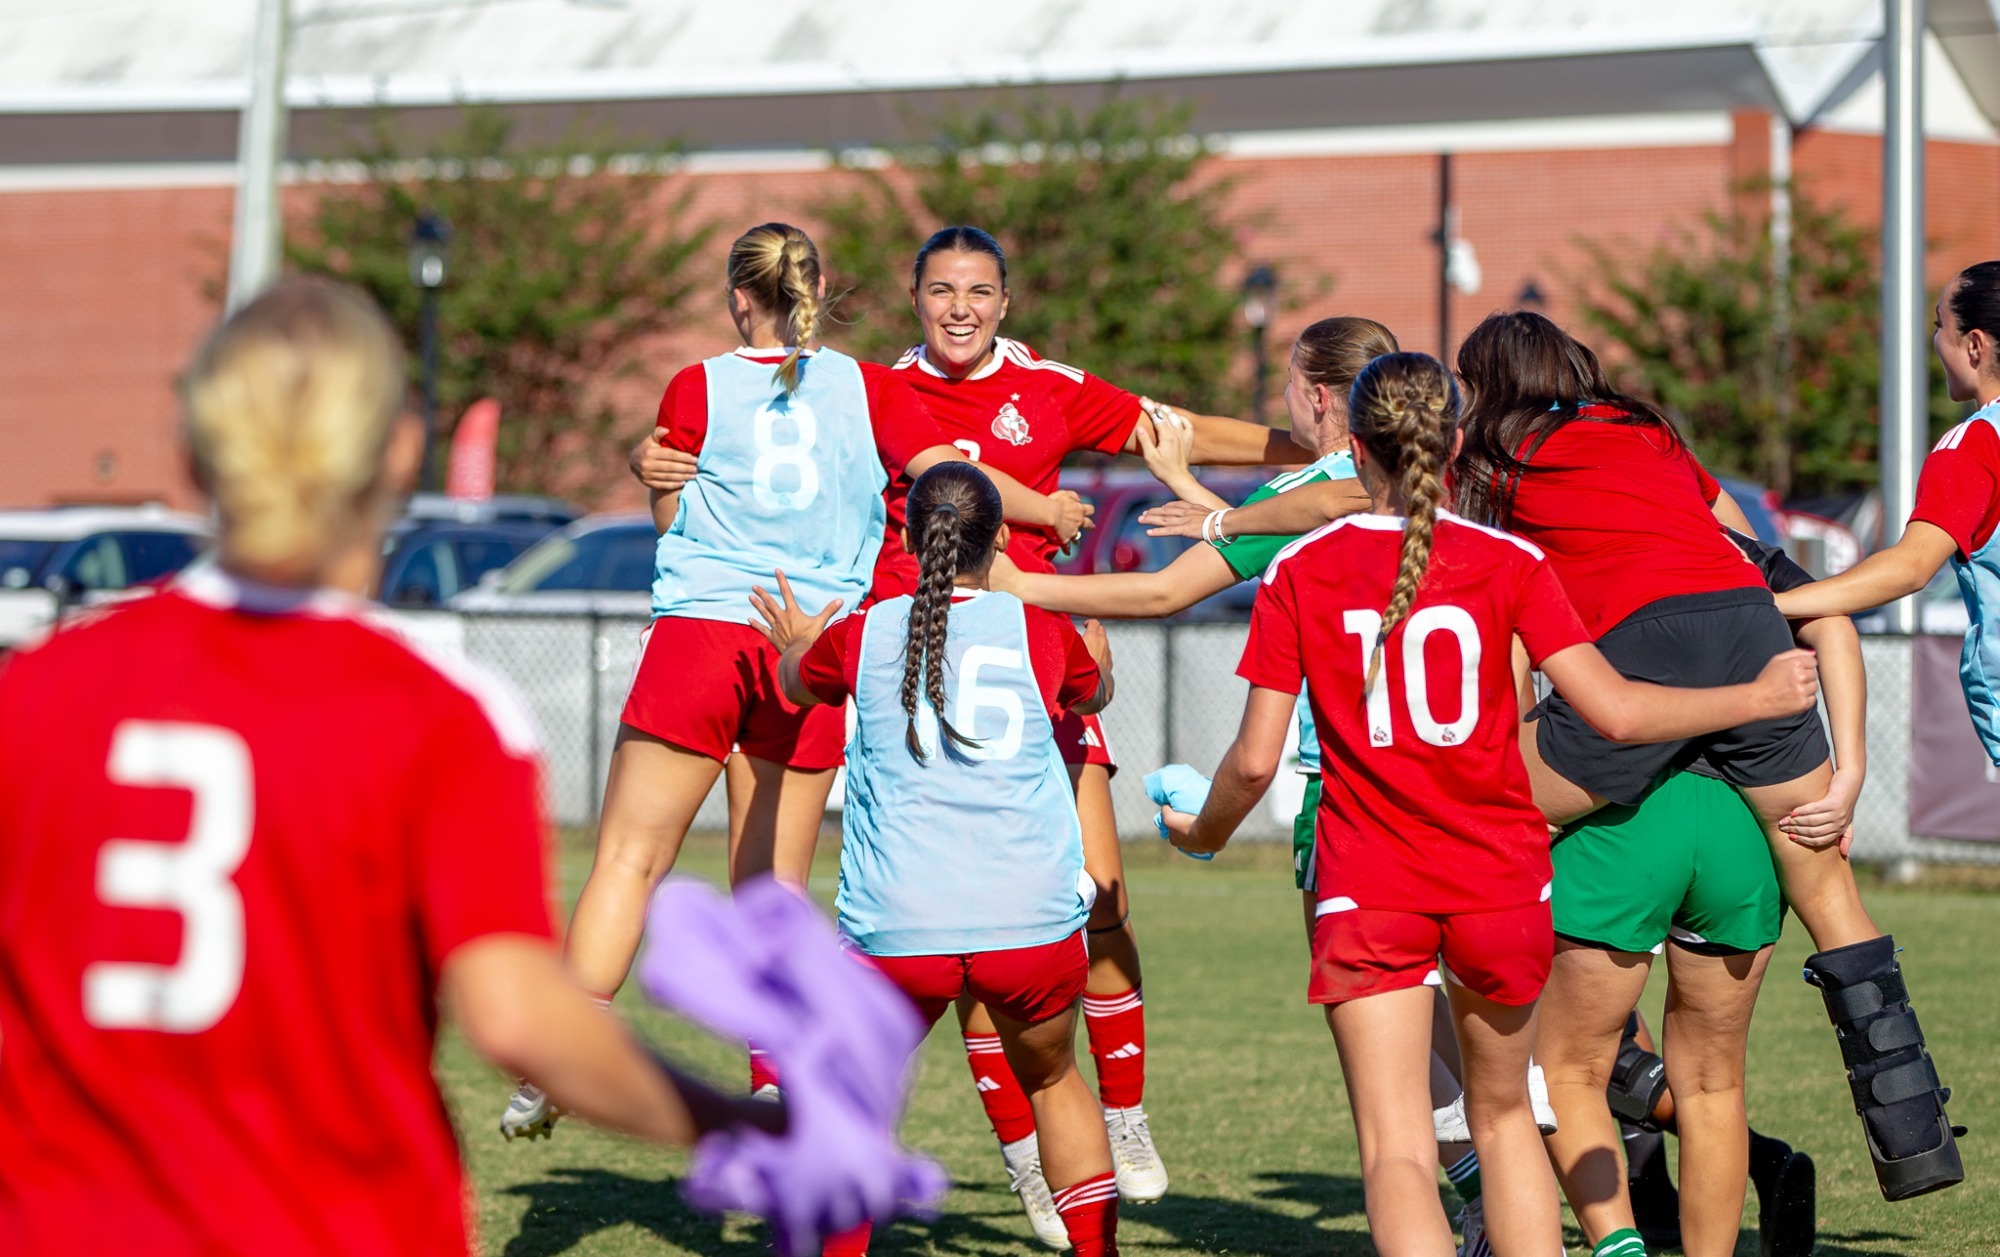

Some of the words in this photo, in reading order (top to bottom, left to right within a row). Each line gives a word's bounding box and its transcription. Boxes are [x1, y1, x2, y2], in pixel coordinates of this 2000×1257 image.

[752, 400, 819, 510] 8
[1343, 605, 1482, 747] 10
[82, 718, 256, 1034] 3
